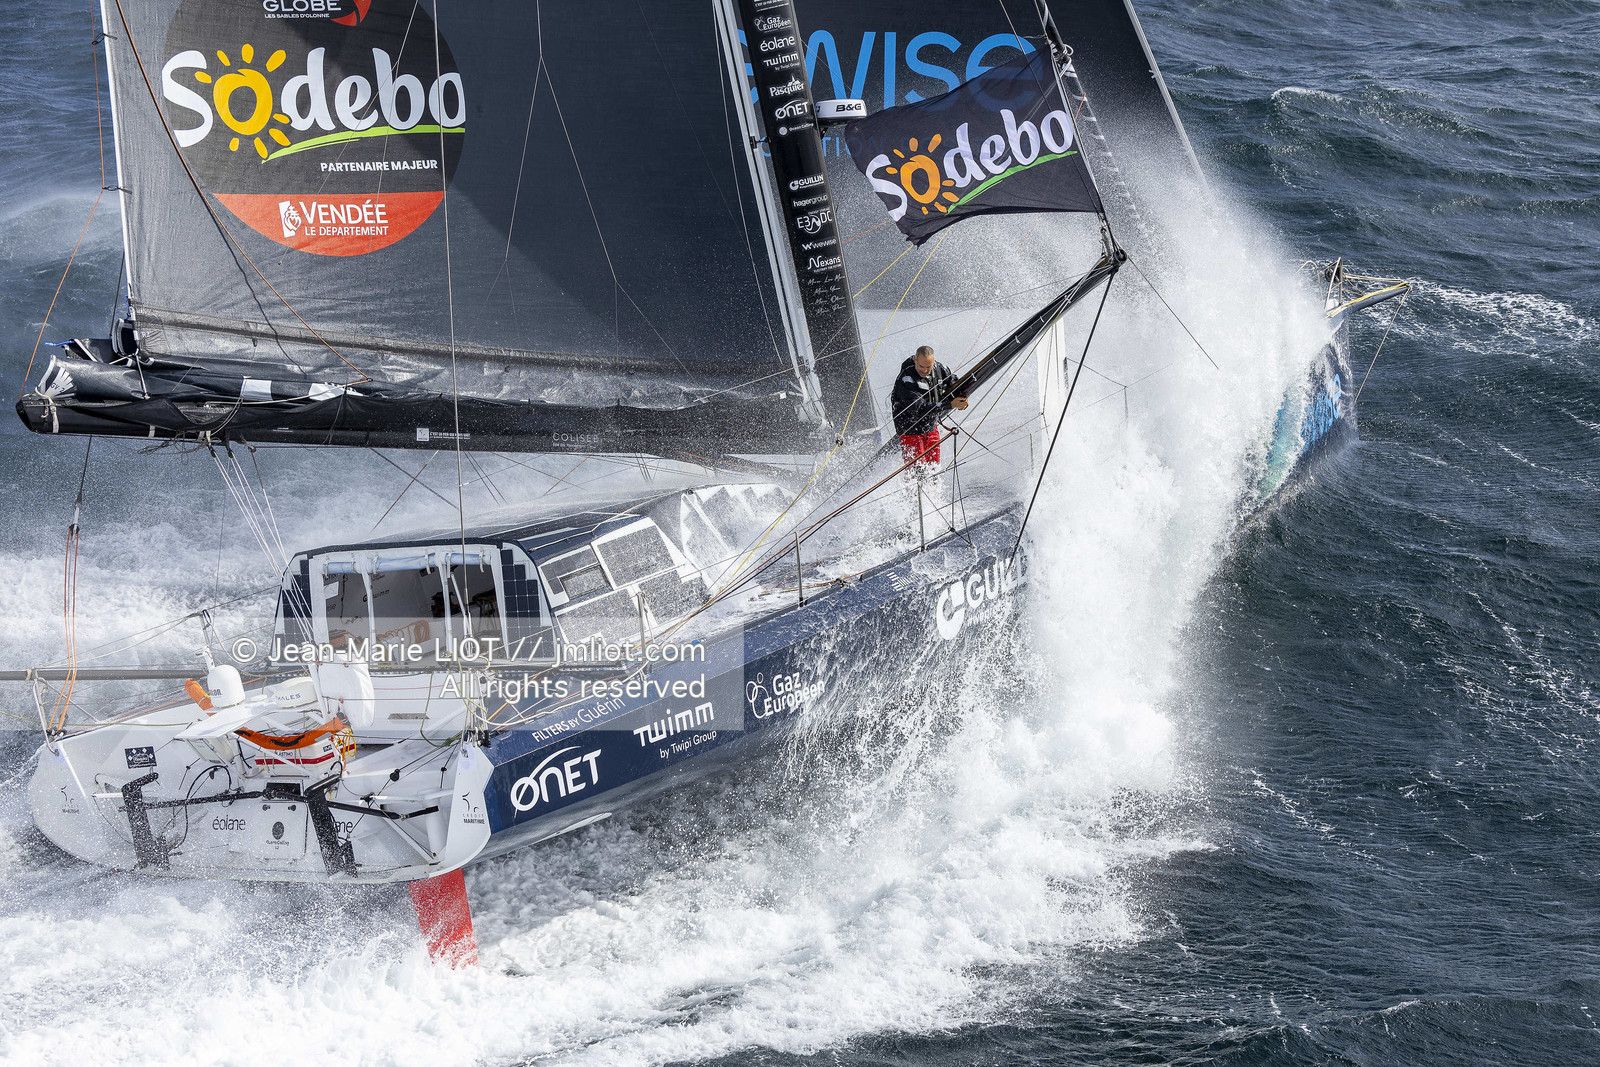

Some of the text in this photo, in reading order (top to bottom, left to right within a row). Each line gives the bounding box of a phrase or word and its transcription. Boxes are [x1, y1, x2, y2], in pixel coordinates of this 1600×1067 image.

[262, 0, 342, 12] GLOBE
[760, 36, 796, 52] éolane
[161, 46, 466, 148] Sodebo
[769, 82, 805, 97] Pasquier
[836, 103, 861, 112] B&G
[320, 159, 438, 172] PARTENAIRE MAJEUR
[866, 109, 1073, 221] Sodebo
[304, 225, 389, 237] LE DEPARTEMENT
[807, 256, 841, 270] Nexans
[772, 672, 802, 695] Gaz
[764, 680, 825, 717] Européen
[532, 720, 570, 742] FILTERS
[577, 697, 626, 723] Guérin
[659, 730, 718, 759] by Twipi Group
